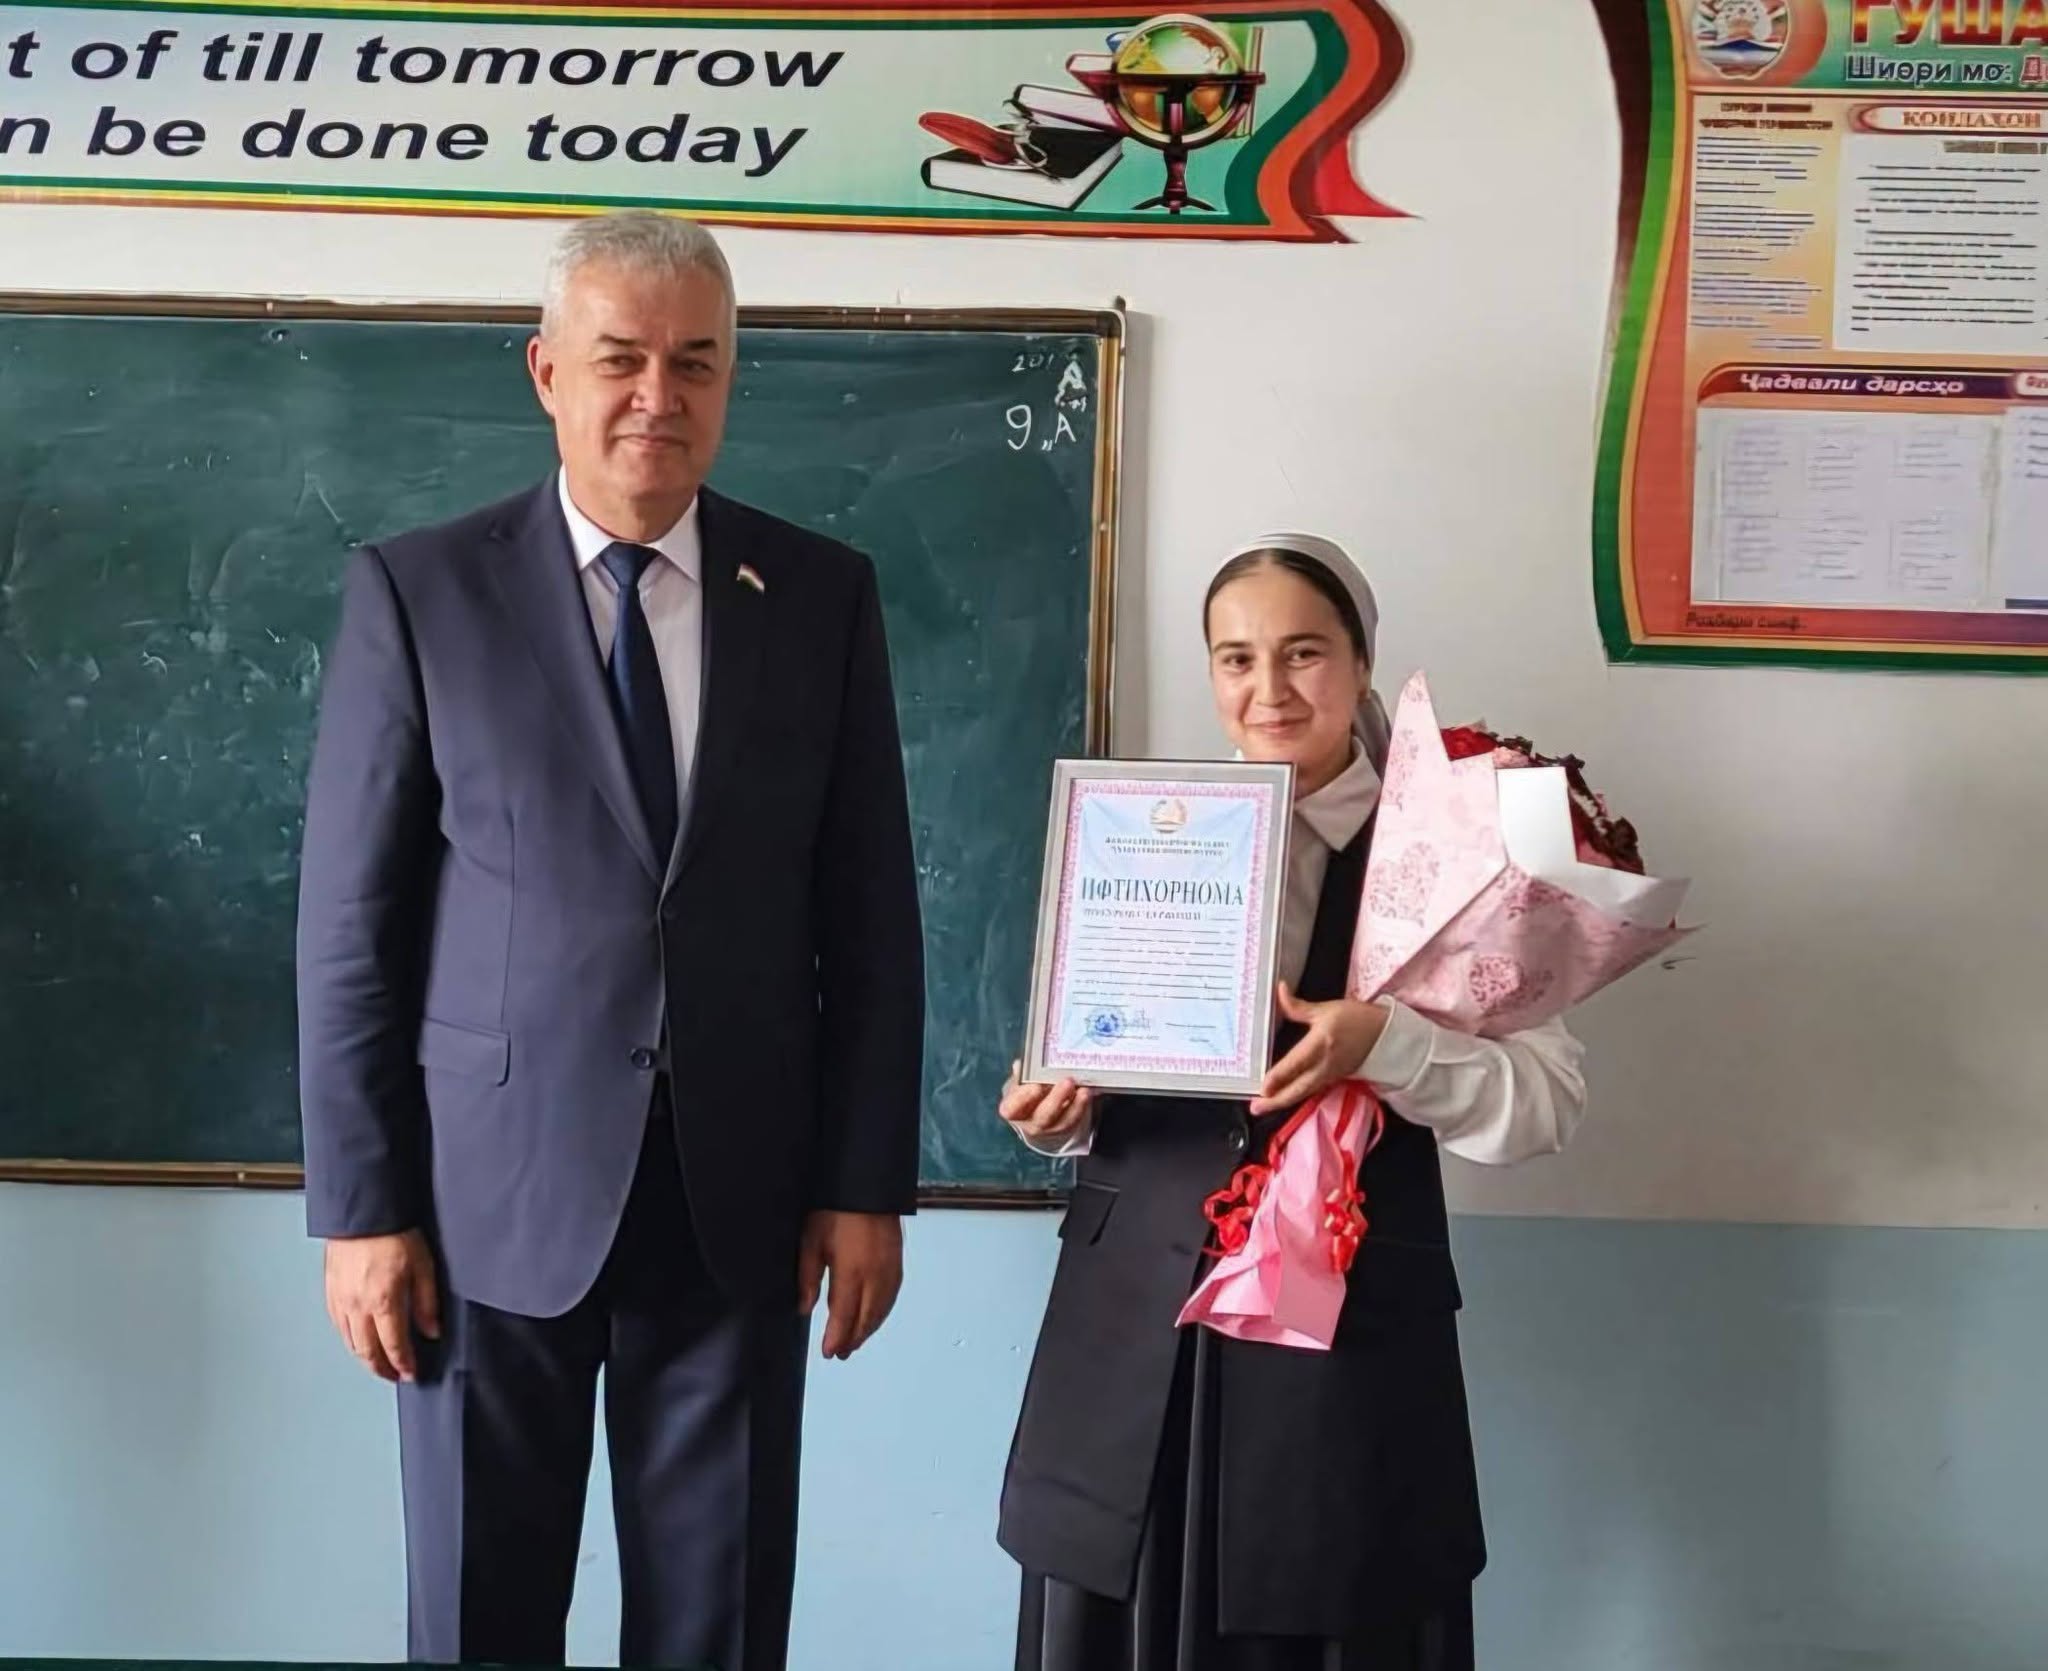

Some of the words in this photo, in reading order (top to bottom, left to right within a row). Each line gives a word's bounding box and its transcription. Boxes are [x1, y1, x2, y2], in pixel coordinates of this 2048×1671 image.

[8, 30, 40, 79] t
[71, 29, 179, 80] of
[202, 31, 323, 82] till
[356, 35, 845, 88] tomorrow
[87, 105, 206, 156] be
[241, 108, 489, 161] done
[527, 113, 808, 178] today
[1006, 404, 1032, 451] 9
